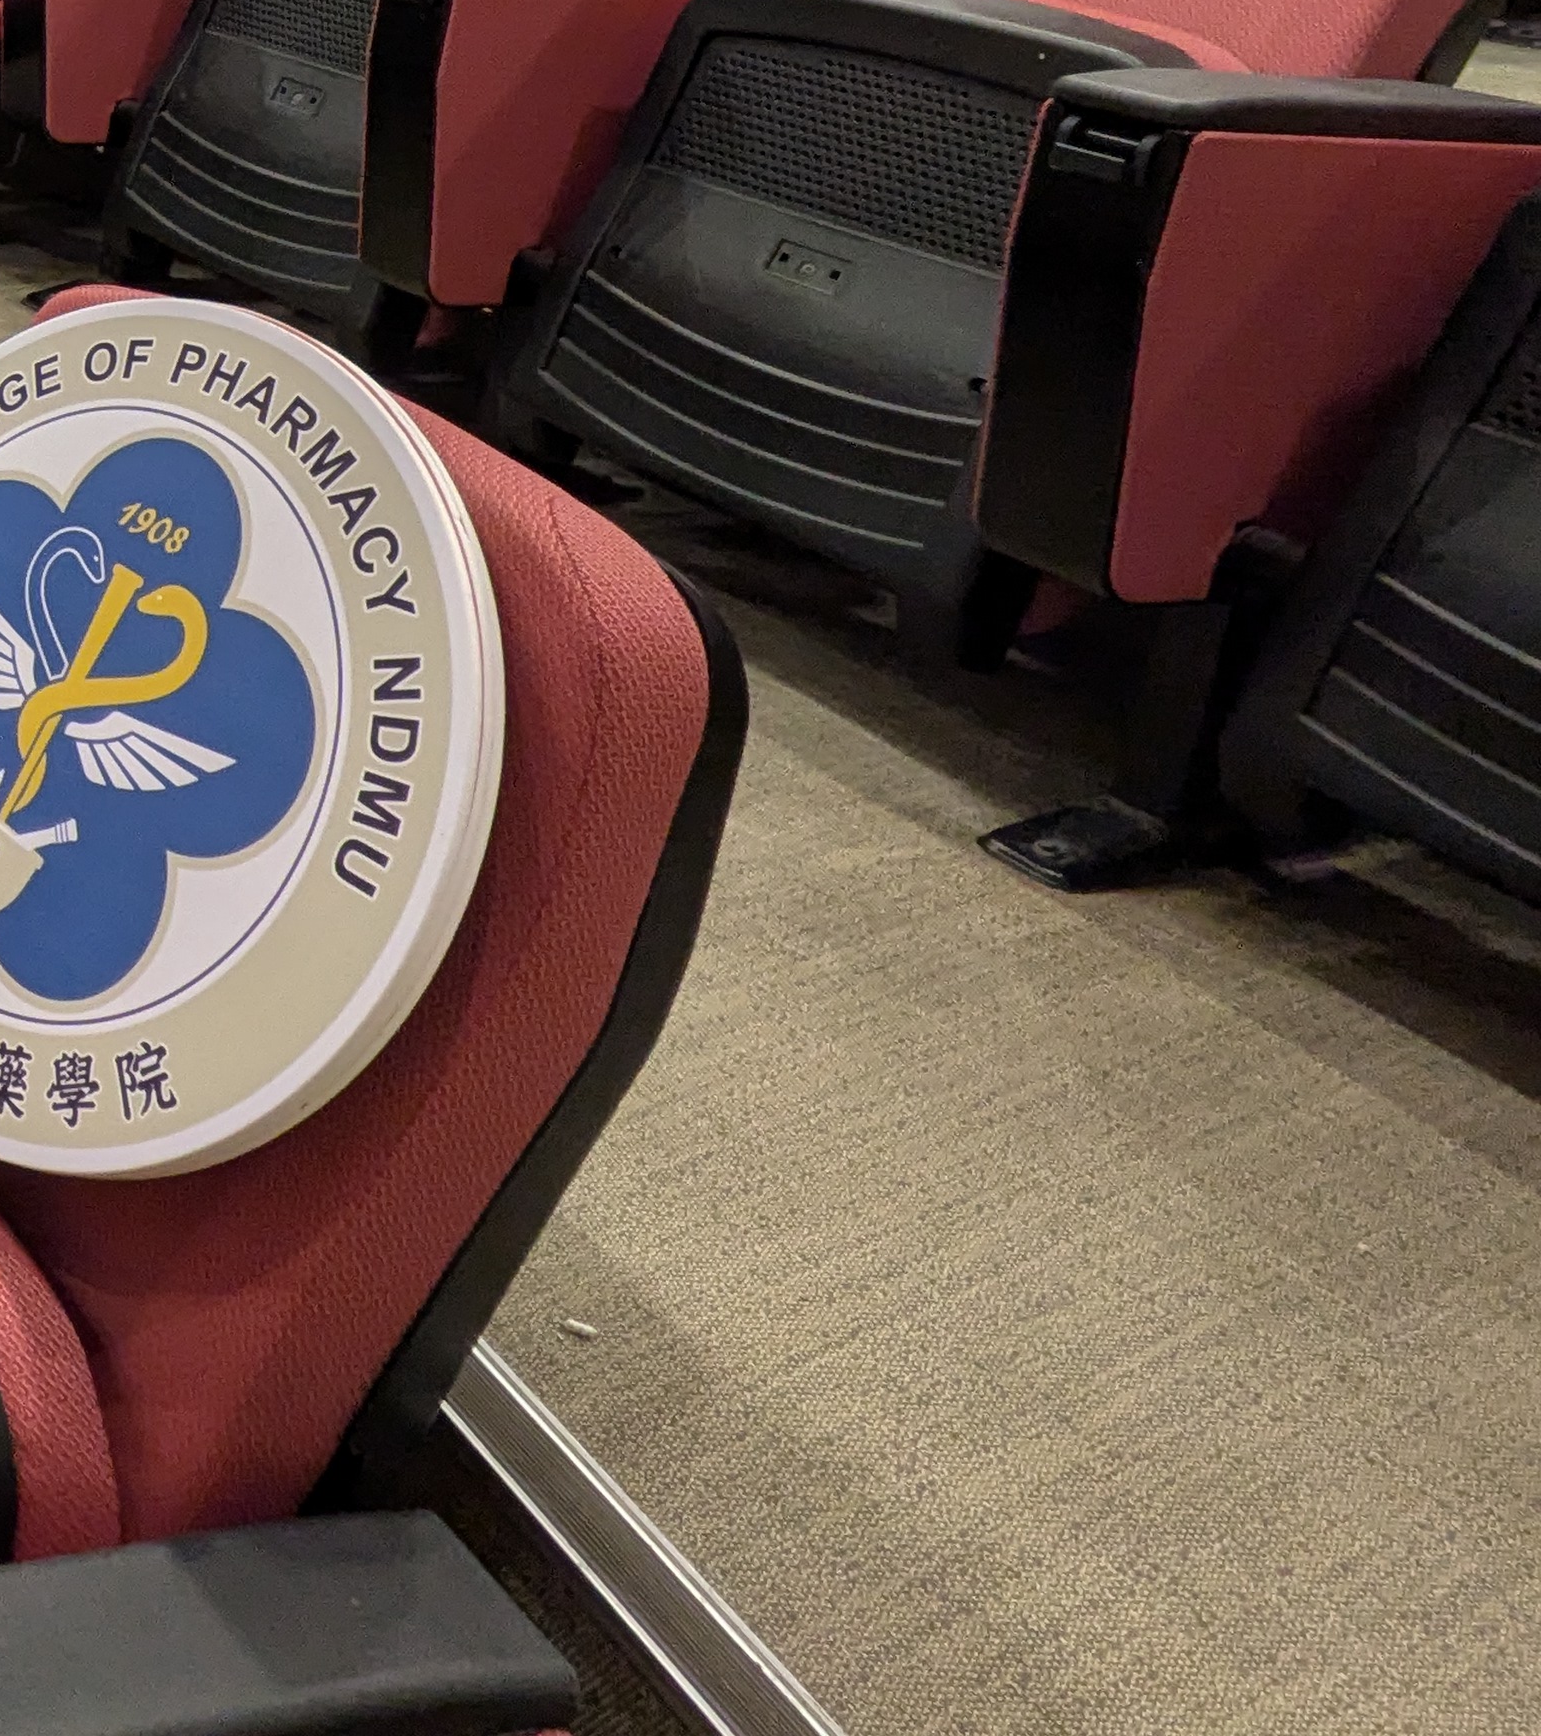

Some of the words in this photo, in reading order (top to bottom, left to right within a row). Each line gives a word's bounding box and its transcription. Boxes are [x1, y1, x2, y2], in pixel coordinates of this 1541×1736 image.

[83, 338, 154, 383] OF
[169, 340, 420, 620] PHARMACY
[335, 655, 422, 900] NDMU
[118, 501, 191, 555] 1908
